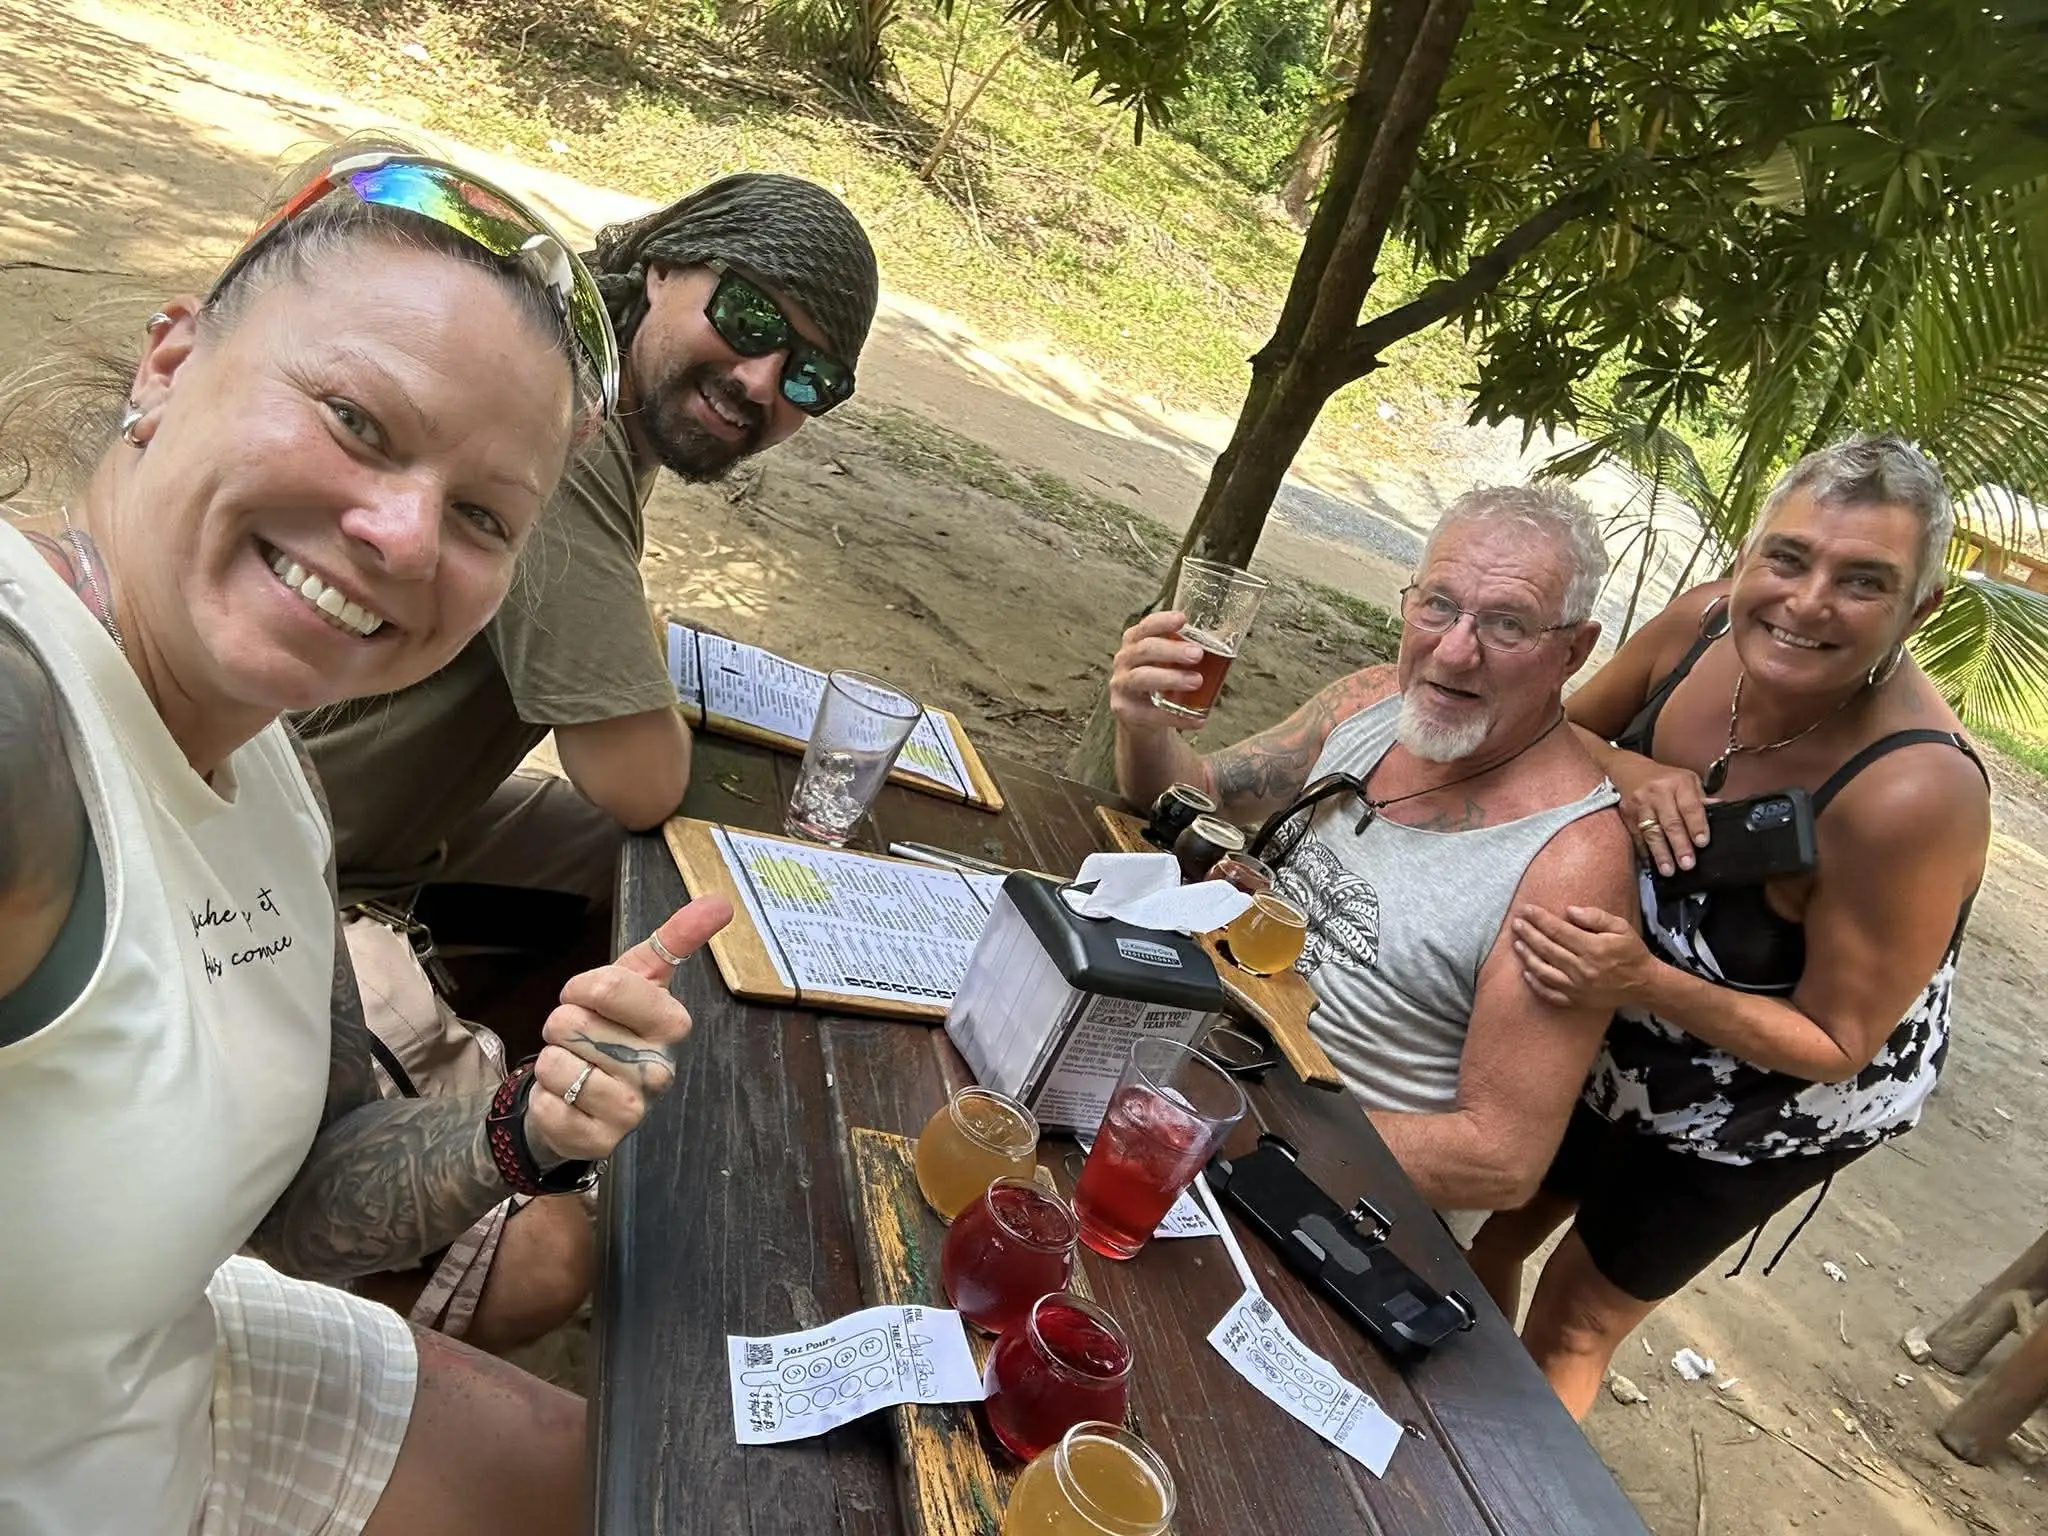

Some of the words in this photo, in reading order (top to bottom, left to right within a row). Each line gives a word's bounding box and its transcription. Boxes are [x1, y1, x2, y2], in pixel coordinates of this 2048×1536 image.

[1145, 1012, 1167, 1021] HEY
[1167, 1011, 1191, 1020] YOU!
[783, 1345, 803, 1356] 5oz
[806, 1336, 837, 1351] Pours
